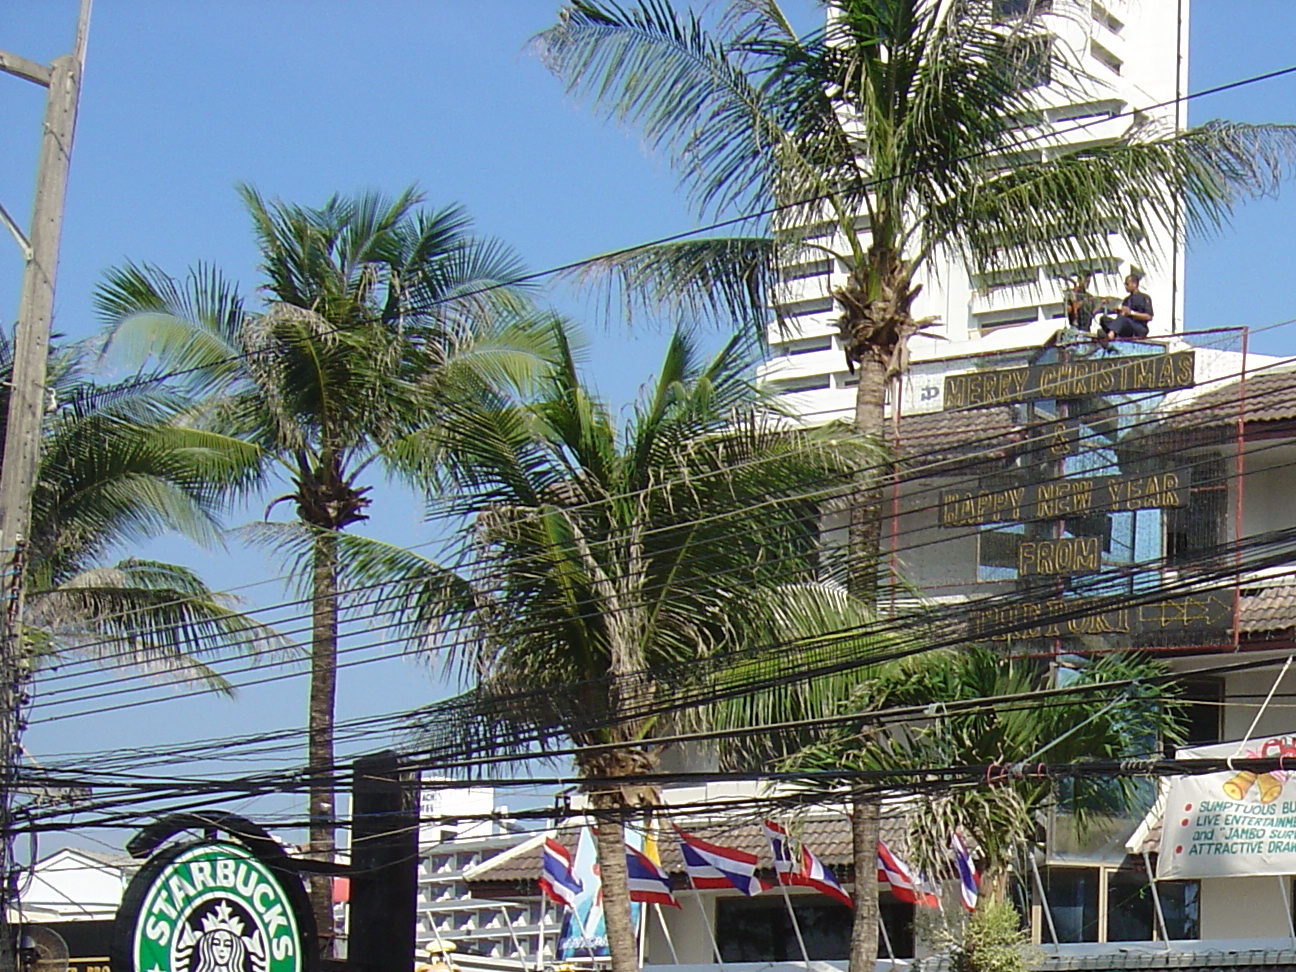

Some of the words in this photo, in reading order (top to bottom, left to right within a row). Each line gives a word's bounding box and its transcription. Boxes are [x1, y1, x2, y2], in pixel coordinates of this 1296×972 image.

[944, 370, 1030, 410] MERRY
[1040, 355, 1193, 397] CHRISTMAS
[943, 487, 1025, 525] HAPPY
[1037, 480, 1093, 518] NEW
[1108, 473, 1180, 510] YEAR
[1019, 538, 1099, 577] FROM
[1196, 814, 1221, 827] LIVE
[1200, 802, 1277, 816] SUMPTUOUS
[1189, 841, 1264, 855] ATTRACTIVE
[1193, 829, 1214, 841] and
[146, 857, 294, 961] STARBUCKS
